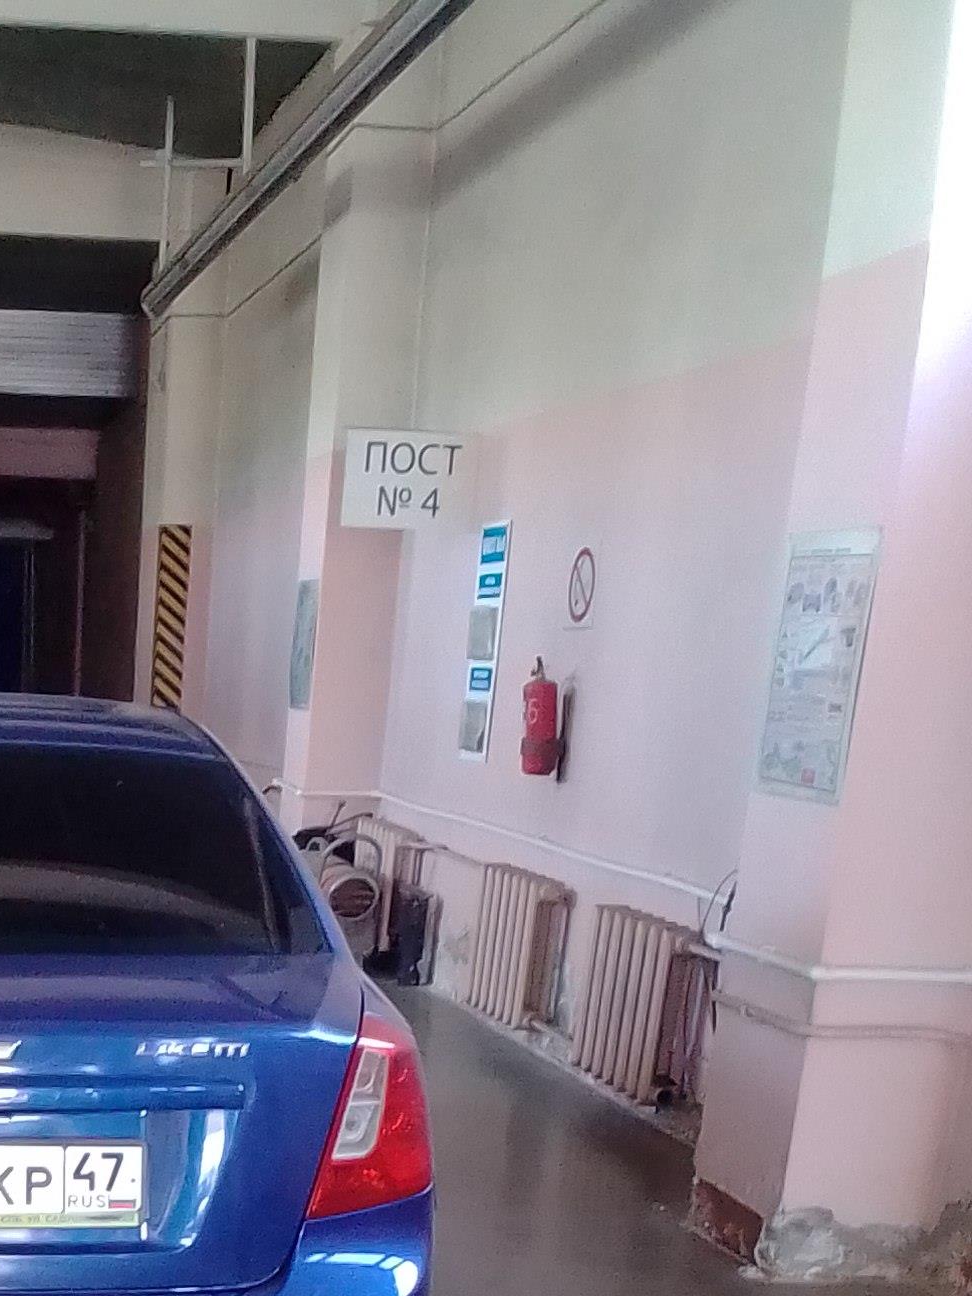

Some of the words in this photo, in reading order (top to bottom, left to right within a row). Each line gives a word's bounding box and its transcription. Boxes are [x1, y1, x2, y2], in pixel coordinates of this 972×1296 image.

[364, 441, 464, 476] ПОСТ
[376, 485, 412, 517] №
[420, 487, 441, 519] 4
[72, 1152, 125, 1192] 47
[67, 1195, 106, 1208] RUS
